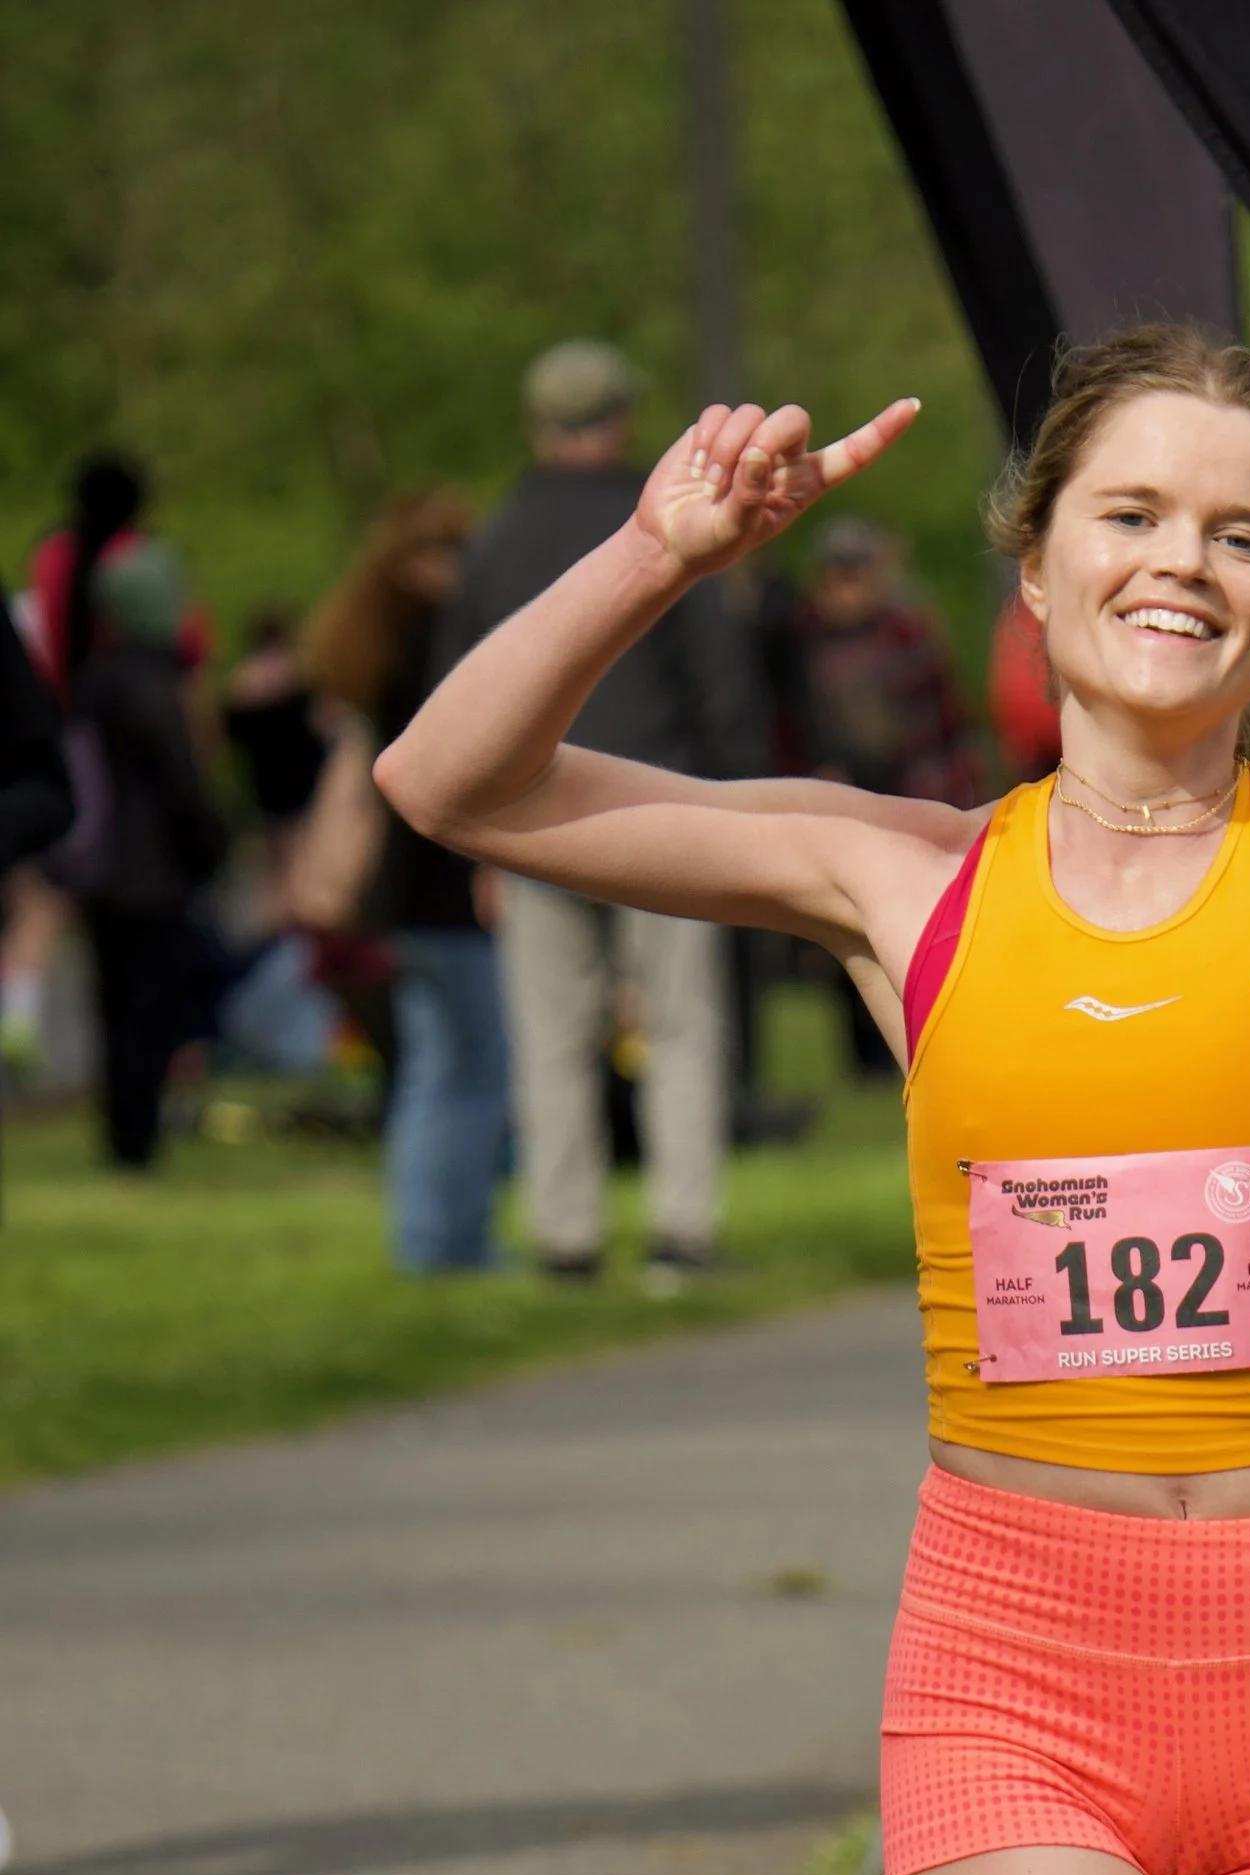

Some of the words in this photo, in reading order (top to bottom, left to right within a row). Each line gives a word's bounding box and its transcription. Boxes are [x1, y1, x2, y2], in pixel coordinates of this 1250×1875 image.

[1001, 1175, 1108, 1194] Snohomish
[1069, 1206, 1107, 1221] Run
[995, 1277, 1033, 1291] HALF
[1055, 1232, 1230, 1336] 182
[986, 1295, 1045, 1305] MARATHON
[1058, 1351, 1097, 1368] RUN
[1101, 1348, 1162, 1366] SUPER
[1166, 1341, 1234, 1361] SERIES
